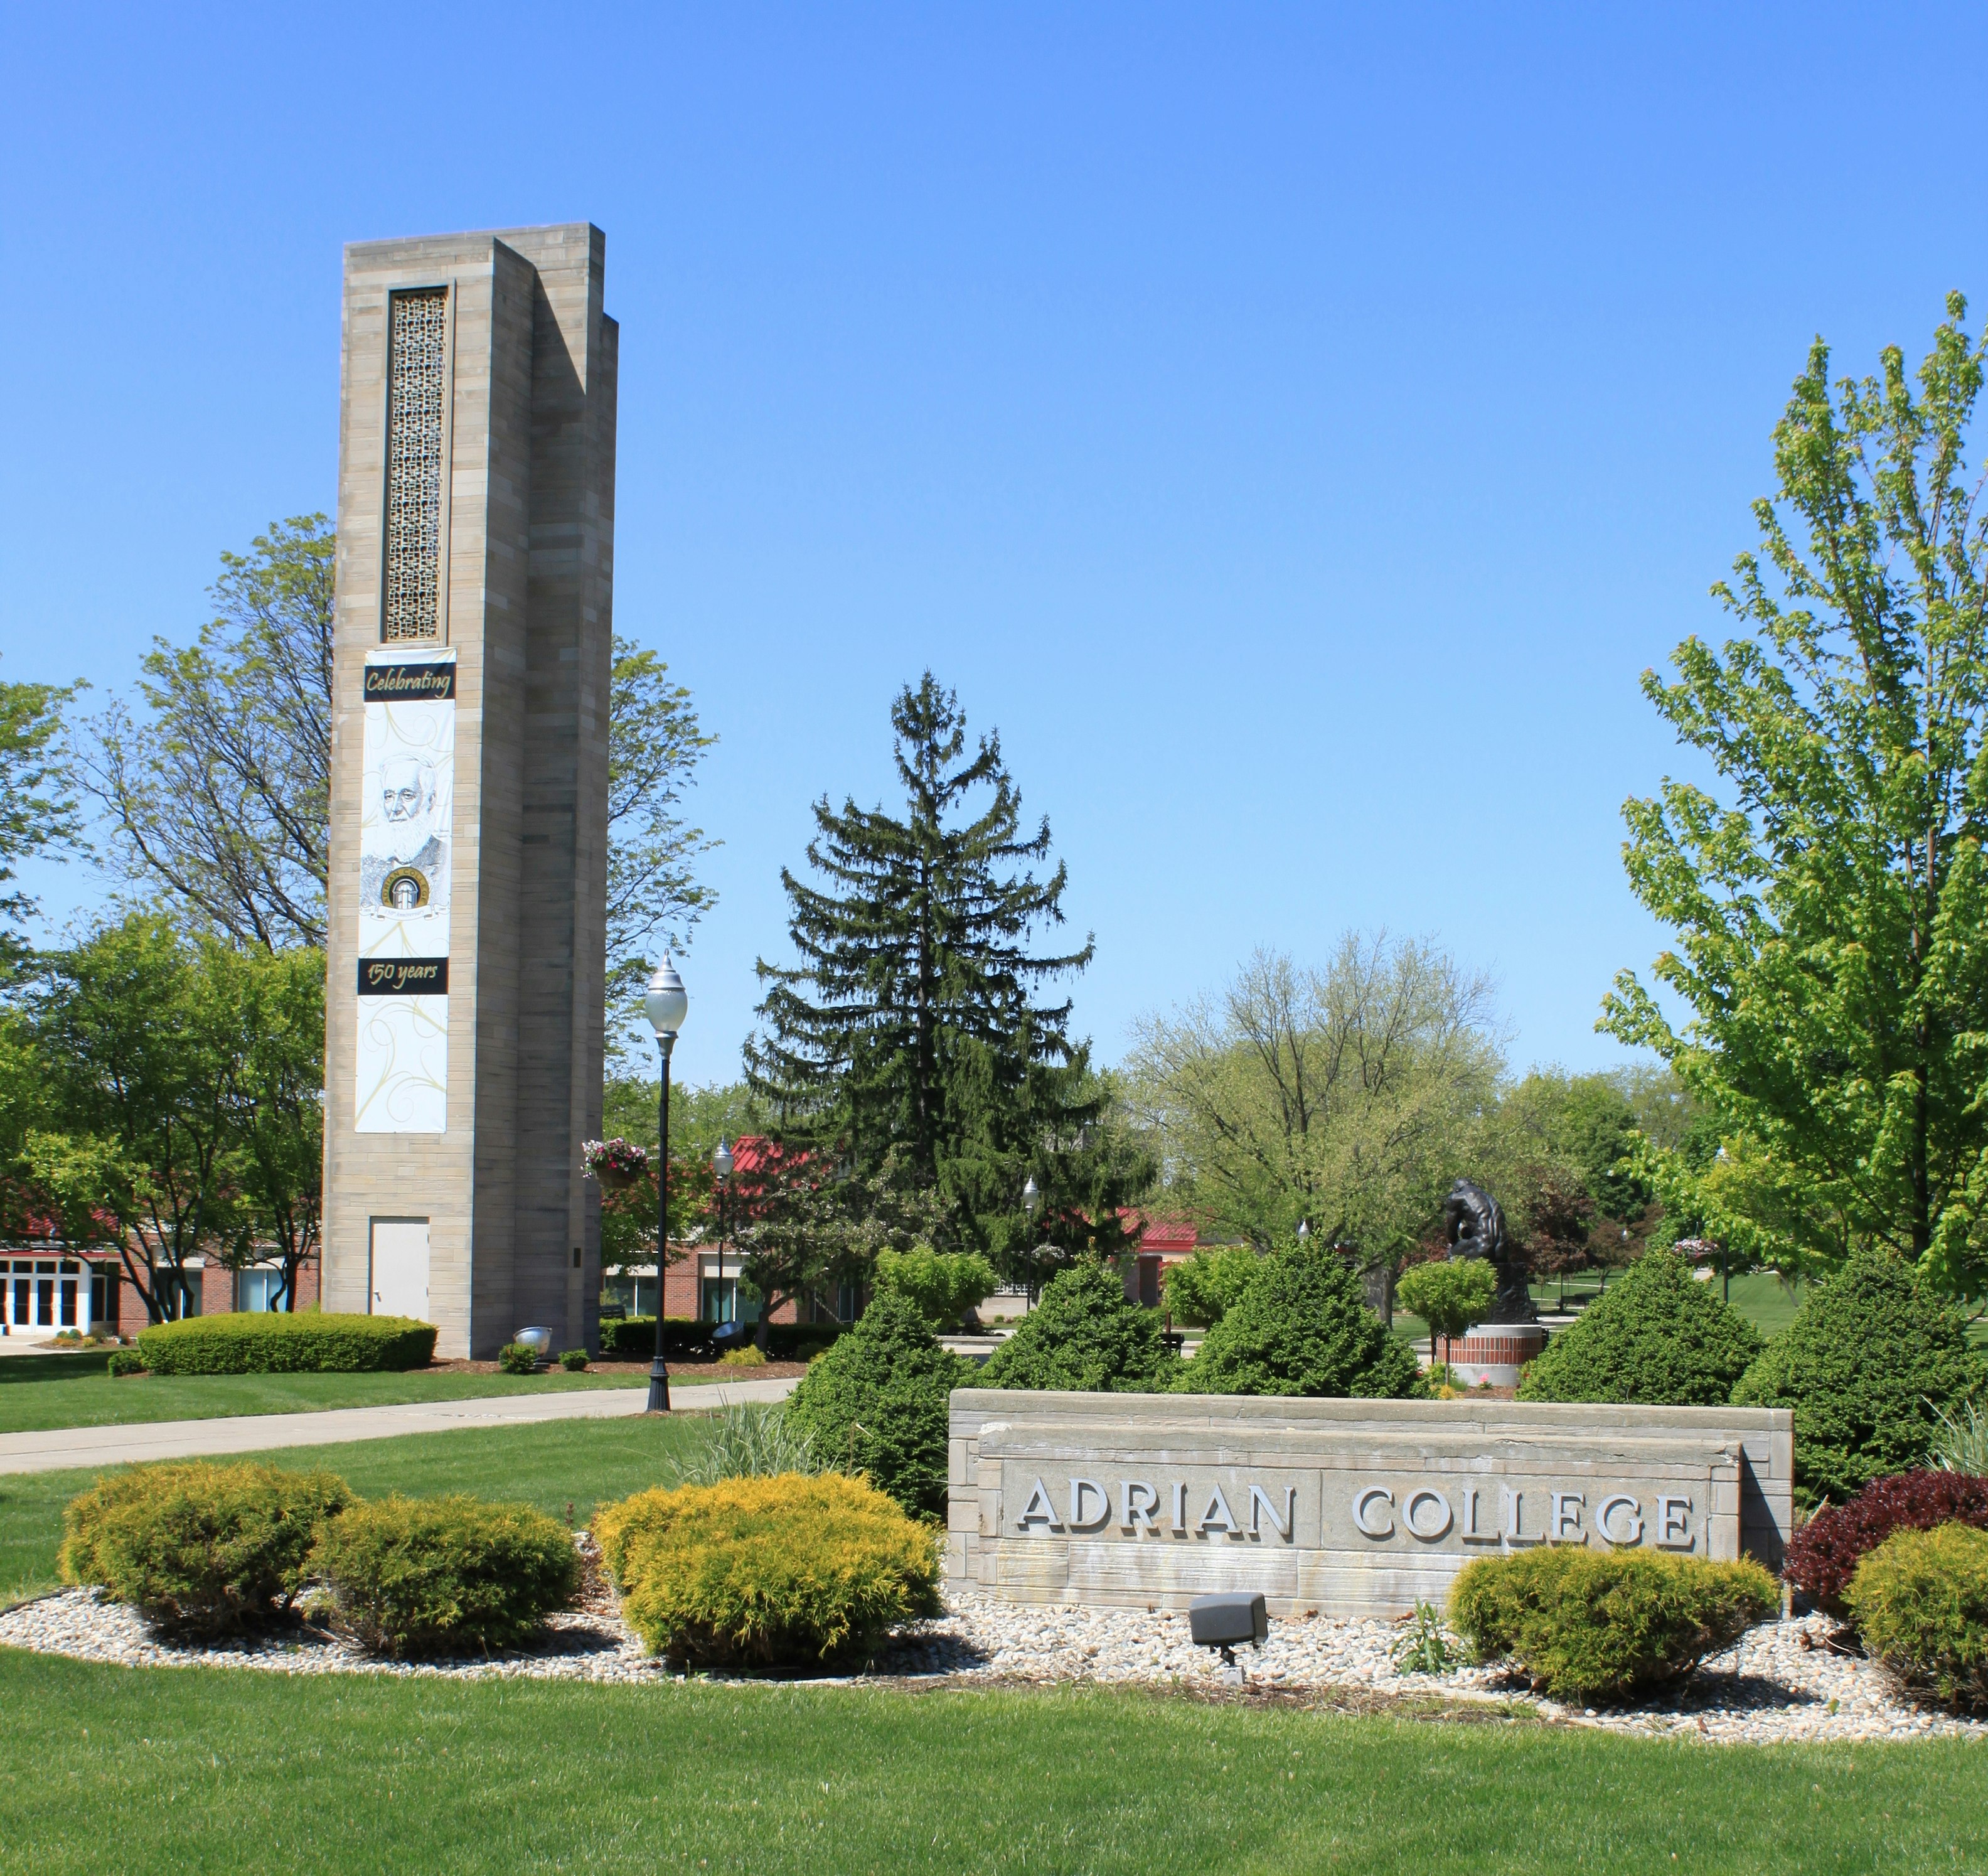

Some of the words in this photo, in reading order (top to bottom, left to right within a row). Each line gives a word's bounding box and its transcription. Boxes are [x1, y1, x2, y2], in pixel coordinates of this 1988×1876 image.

[366, 667, 451, 699] Celebrating
[383, 871, 400, 903] ADRIAN
[403, 869, 427, 903] COLLEGE
[368, 963, 395, 985] 150
[392, 965, 438, 989] years
[1017, 1477, 1295, 1536] ADRIAN
[1352, 1485, 1693, 1547] COLLEGE
